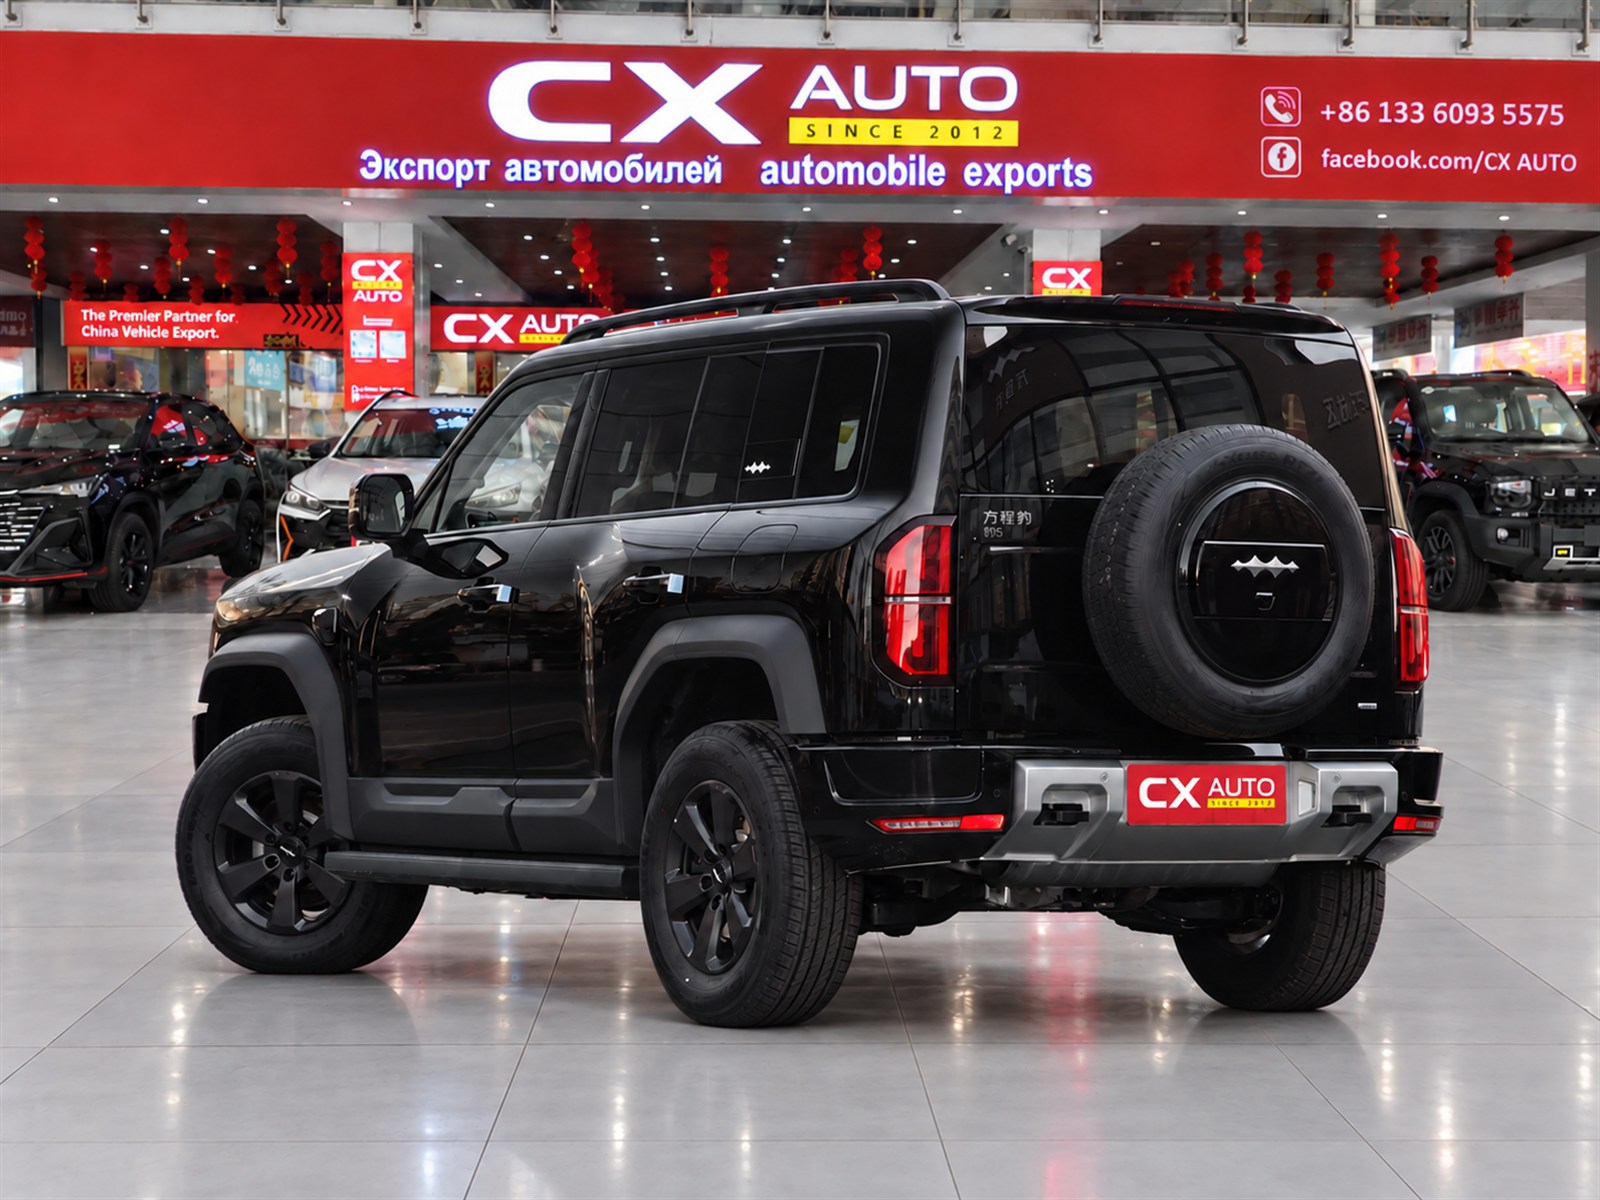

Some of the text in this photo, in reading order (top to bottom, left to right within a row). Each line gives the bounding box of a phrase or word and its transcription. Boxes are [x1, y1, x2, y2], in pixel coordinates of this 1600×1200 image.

[487, 60, 1018, 144] CX AUTO
[1320, 101, 1564, 126] +86 133 6093 5575
[806, 123, 1005, 141] SINCE 2012
[359, 149, 722, 188] Экспорт автомобилей
[760, 153, 1093, 194] automobile exports
[1321, 148, 1577, 174] facebook.com/CX AUTO
[350, 259, 402, 284] CX
[1041, 267, 1092, 290] CX
[352, 289, 403, 304] AUTO
[81, 308, 236, 323] The Premier Partner for
[81, 324, 219, 341] China Vehicle Export.
[443, 313, 516, 344] CX
[1139, 777, 1275, 809] CX AUTO
